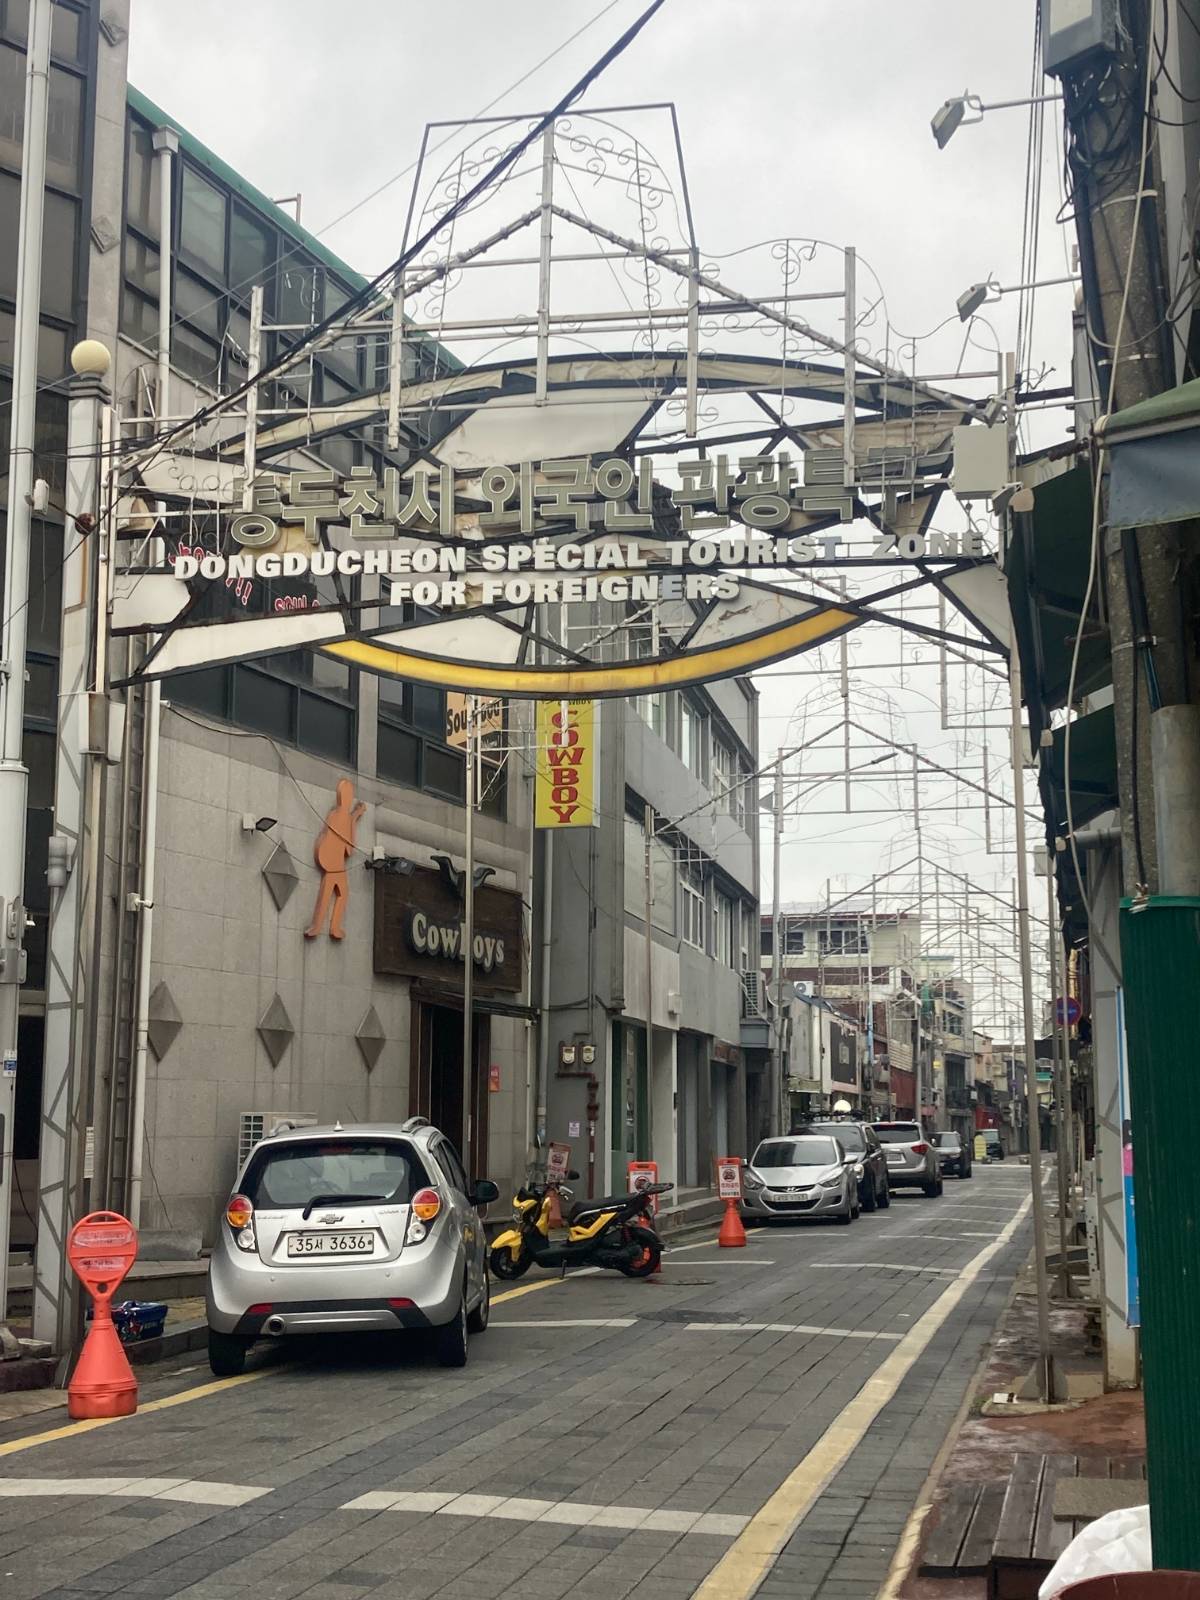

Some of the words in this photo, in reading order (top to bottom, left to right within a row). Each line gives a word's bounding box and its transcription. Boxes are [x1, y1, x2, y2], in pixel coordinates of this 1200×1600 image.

[231, 464, 456, 548] 동두천시
[480, 455, 655, 532] 외국인
[173, 547, 467, 581] DONGDUCHEON
[481, 542, 653, 572] SPECIAL
[666, 536, 842, 568] TOURIST
[872, 532, 985, 560] ZONE
[389, 580, 467, 607] FOR
[481, 573, 742, 605] FOREIGNERS
[547, 710, 584, 823] COWBOY
[296, 1238, 323, 1252] 35서
[330, 1235, 366, 1250] 3636
